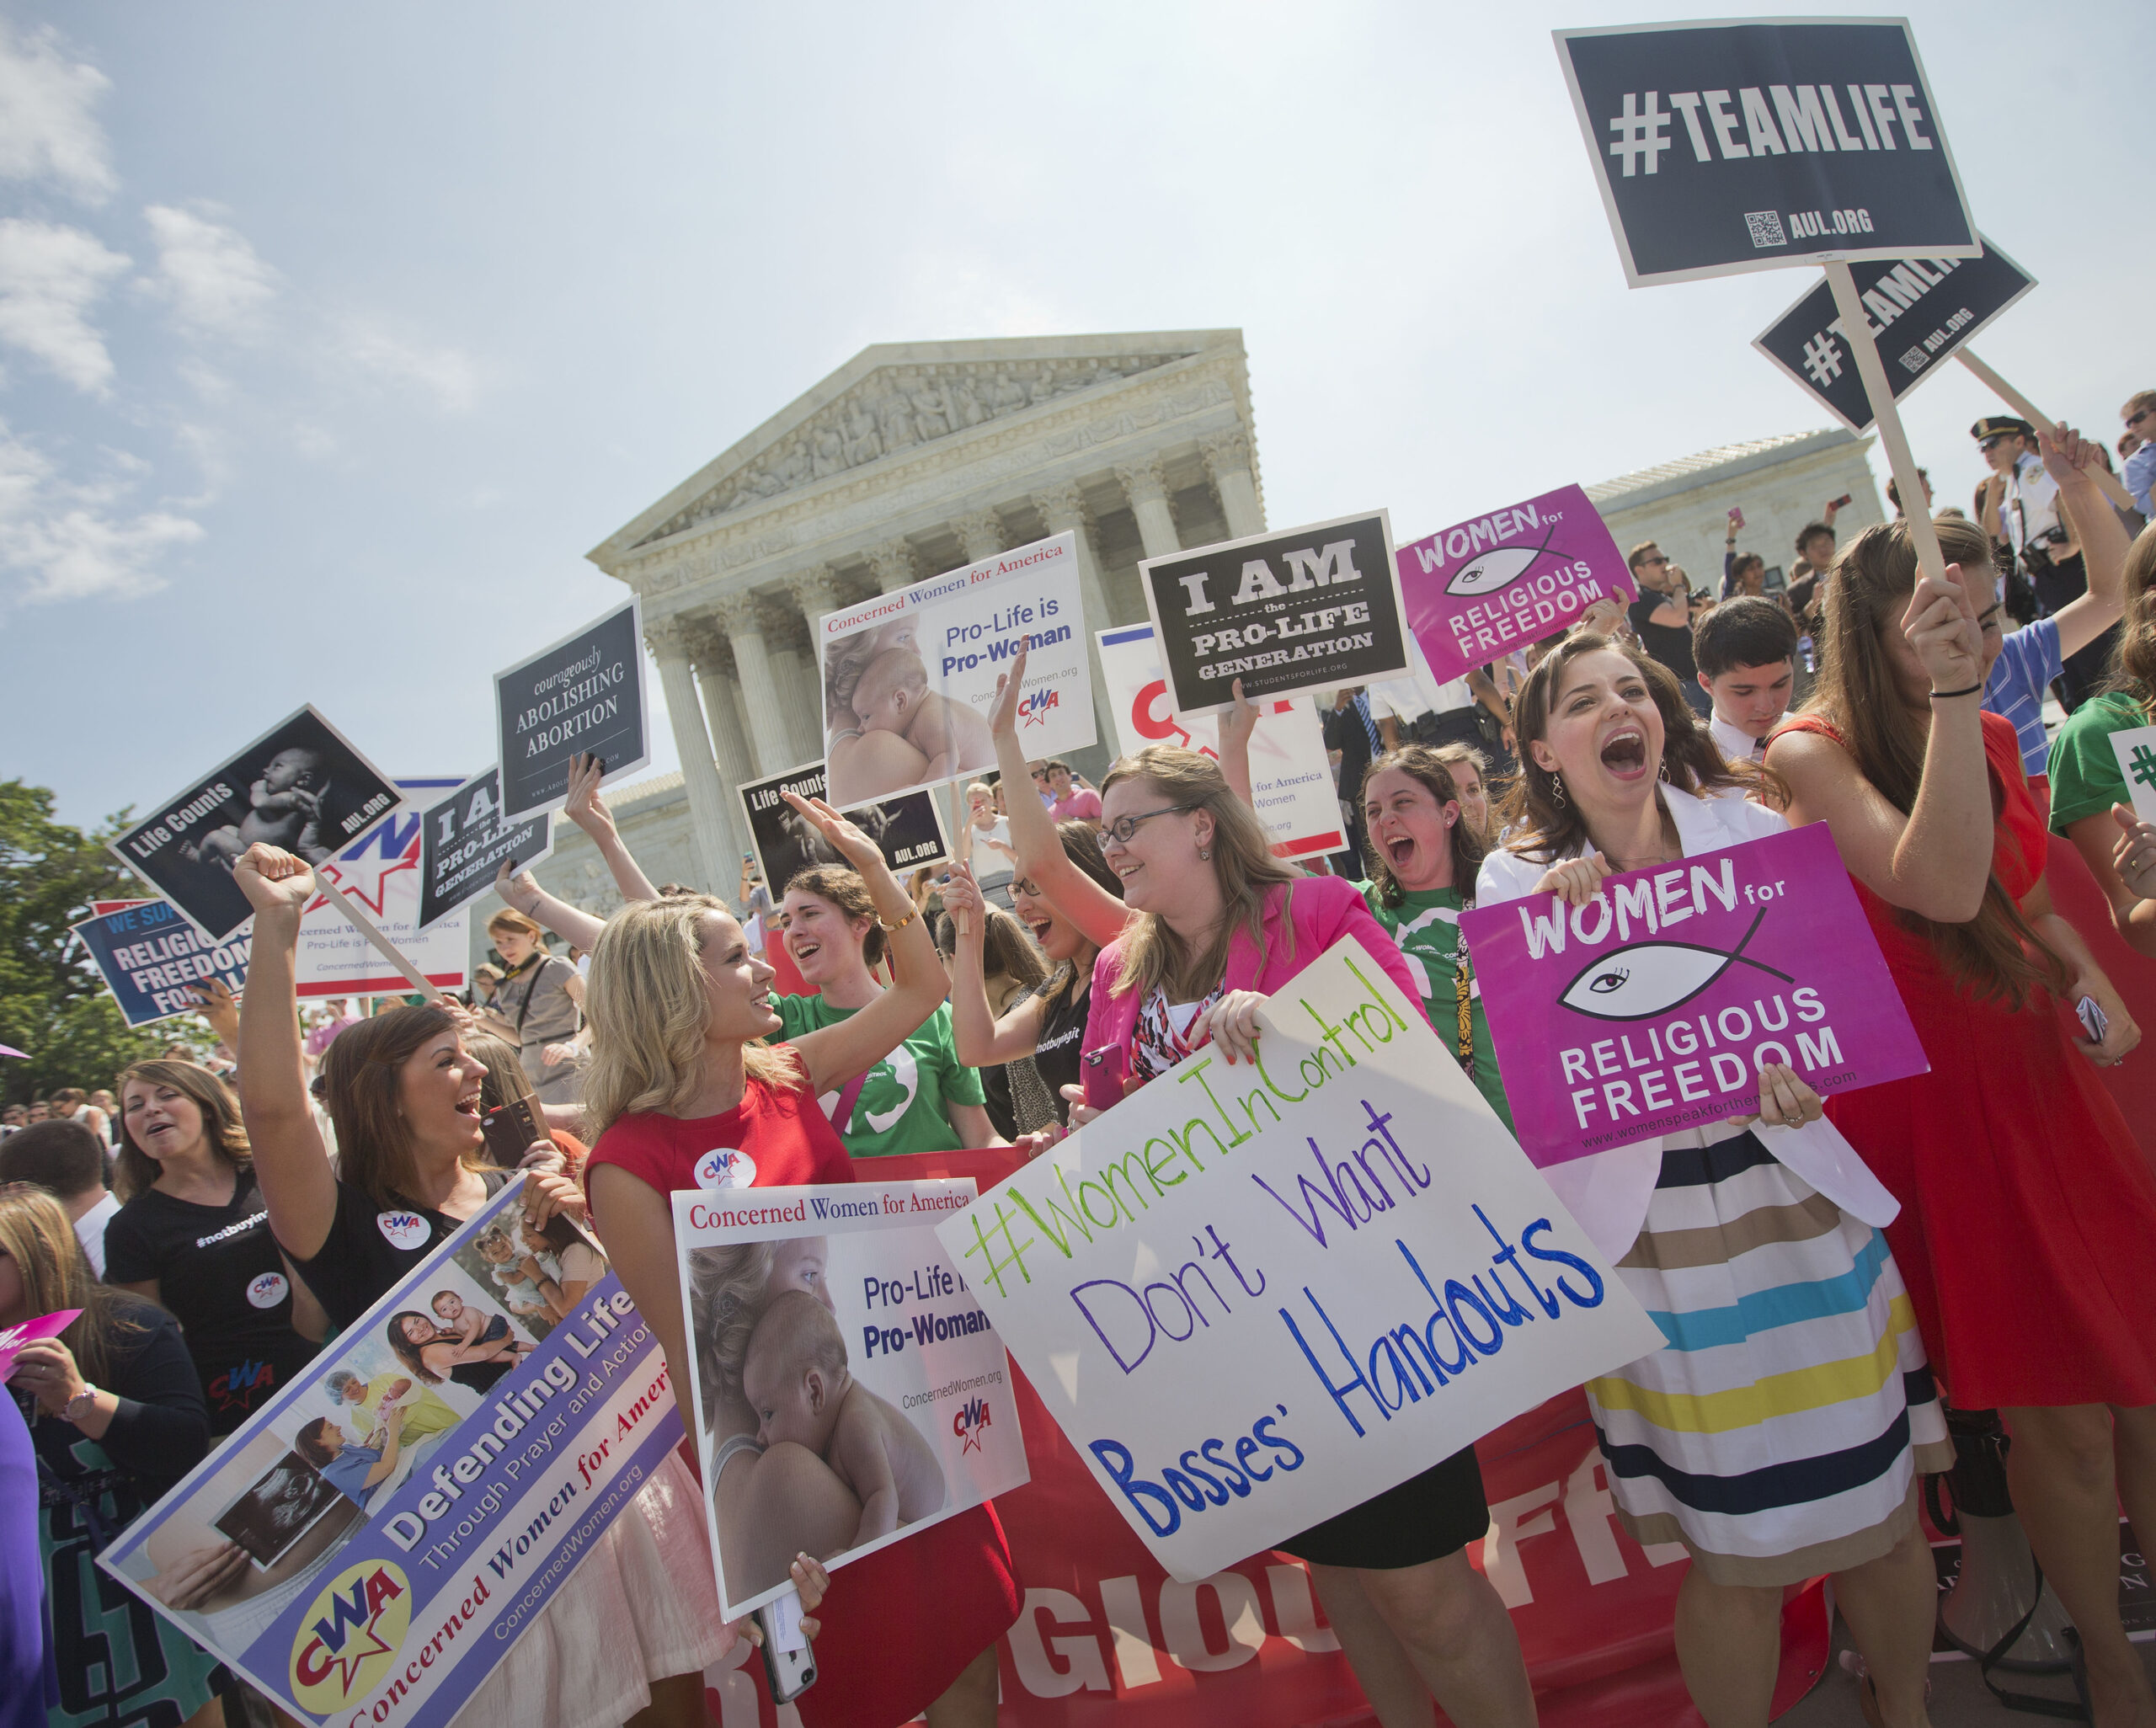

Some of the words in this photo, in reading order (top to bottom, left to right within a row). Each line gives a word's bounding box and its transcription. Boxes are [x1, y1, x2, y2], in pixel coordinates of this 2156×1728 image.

[1609, 83, 1933, 178] #TEAMLIFE
[1789, 209, 1875, 239] AUL.ORG
[1922, 307, 1975, 354] AUL.ORG
[1414, 504, 1540, 574] WOMEN
[1541, 511, 1563, 525] for
[827, 595, 905, 632] Concerned
[908, 578, 966, 605] Women
[969, 569, 992, 585] for
[995, 546, 1064, 576] America
[1178, 571, 1215, 616] I
[1230, 538, 1363, 605] AM
[1448, 560, 1592, 637] RELIGIOUS
[946, 605, 1033, 648] Pro-Life
[1039, 598, 1059, 618] is
[1191, 600, 1370, 657] PRO-LIFE
[1264, 602, 1287, 614] the
[1457, 579, 1604, 659] FREEDOM
[534, 645, 601, 696] courageously
[942, 624, 1072, 677] Pro-Woman
[1198, 632, 1374, 680] GENERATION
[515, 661, 625, 733] ABOLISHING
[971, 666, 1078, 704] ConcWomen.org
[1017, 687, 1059, 717] CWA
[526, 695, 618, 758] ABORTION
[750, 788, 780, 812] Life
[1256, 781, 1273, 792] for
[1275, 771, 1323, 788] America
[129, 824, 173, 859] Life
[164, 781, 234, 832] Counts
[339, 792, 392, 835] AUL.ORG
[435, 824, 534, 898] GENERATION
[894, 840, 938, 864] AUL.ORG
[104, 911, 138, 935] WE
[299, 925, 341, 936] cerned
[1518, 858, 1738, 961] WOMEN
[1743, 879, 1786, 905] for
[131, 937, 252, 994] FREEDOM
[307, 938, 350, 950] Pro-Life
[353, 938, 361, 947] is
[1559, 986, 1827, 1085] RELIGIOUS
[1571, 1025, 1845, 1130] FREEDOM
[964, 956, 1409, 1299] #WomenInControl
[703, 1153, 741, 1179] CWA
[195, 1209, 268, 1249] #notbuyin
[383, 1214, 420, 1229] CWA
[689, 1198, 807, 1230] Concerned
[809, 1196, 879, 1221] Women
[882, 1193, 907, 1215] for
[909, 1190, 969, 1213] America
[1069, 1224, 1267, 1375] Don't
[1251, 1099, 1431, 1250] Want
[253, 1276, 281, 1293] CWA
[863, 1264, 954, 1309] Pro-Life
[863, 1309, 991, 1358] Pro-Woman
[209, 1358, 275, 1400] CWA
[902, 1369, 1003, 1411] ConcernedWomen.org
[1087, 1403, 1305, 1539] Bosses'
[1278, 1203, 1605, 1438] Handouts
[382, 1355, 581, 1554] Defending
[563, 1288, 637, 1360] Life
[953, 1395, 992, 1437] CWA
[418, 1475, 511, 1571] Through
[503, 1411, 569, 1482] Prayer
[567, 1372, 606, 1415] and
[348, 1574, 492, 1728] Concerned
[486, 1480, 579, 1582] Women
[575, 1438, 611, 1491] for
[613, 1361, 672, 1445] Ameri
[493, 1463, 645, 1642] ConcernedWomen.org
[295, 1565, 405, 1688] CWA
